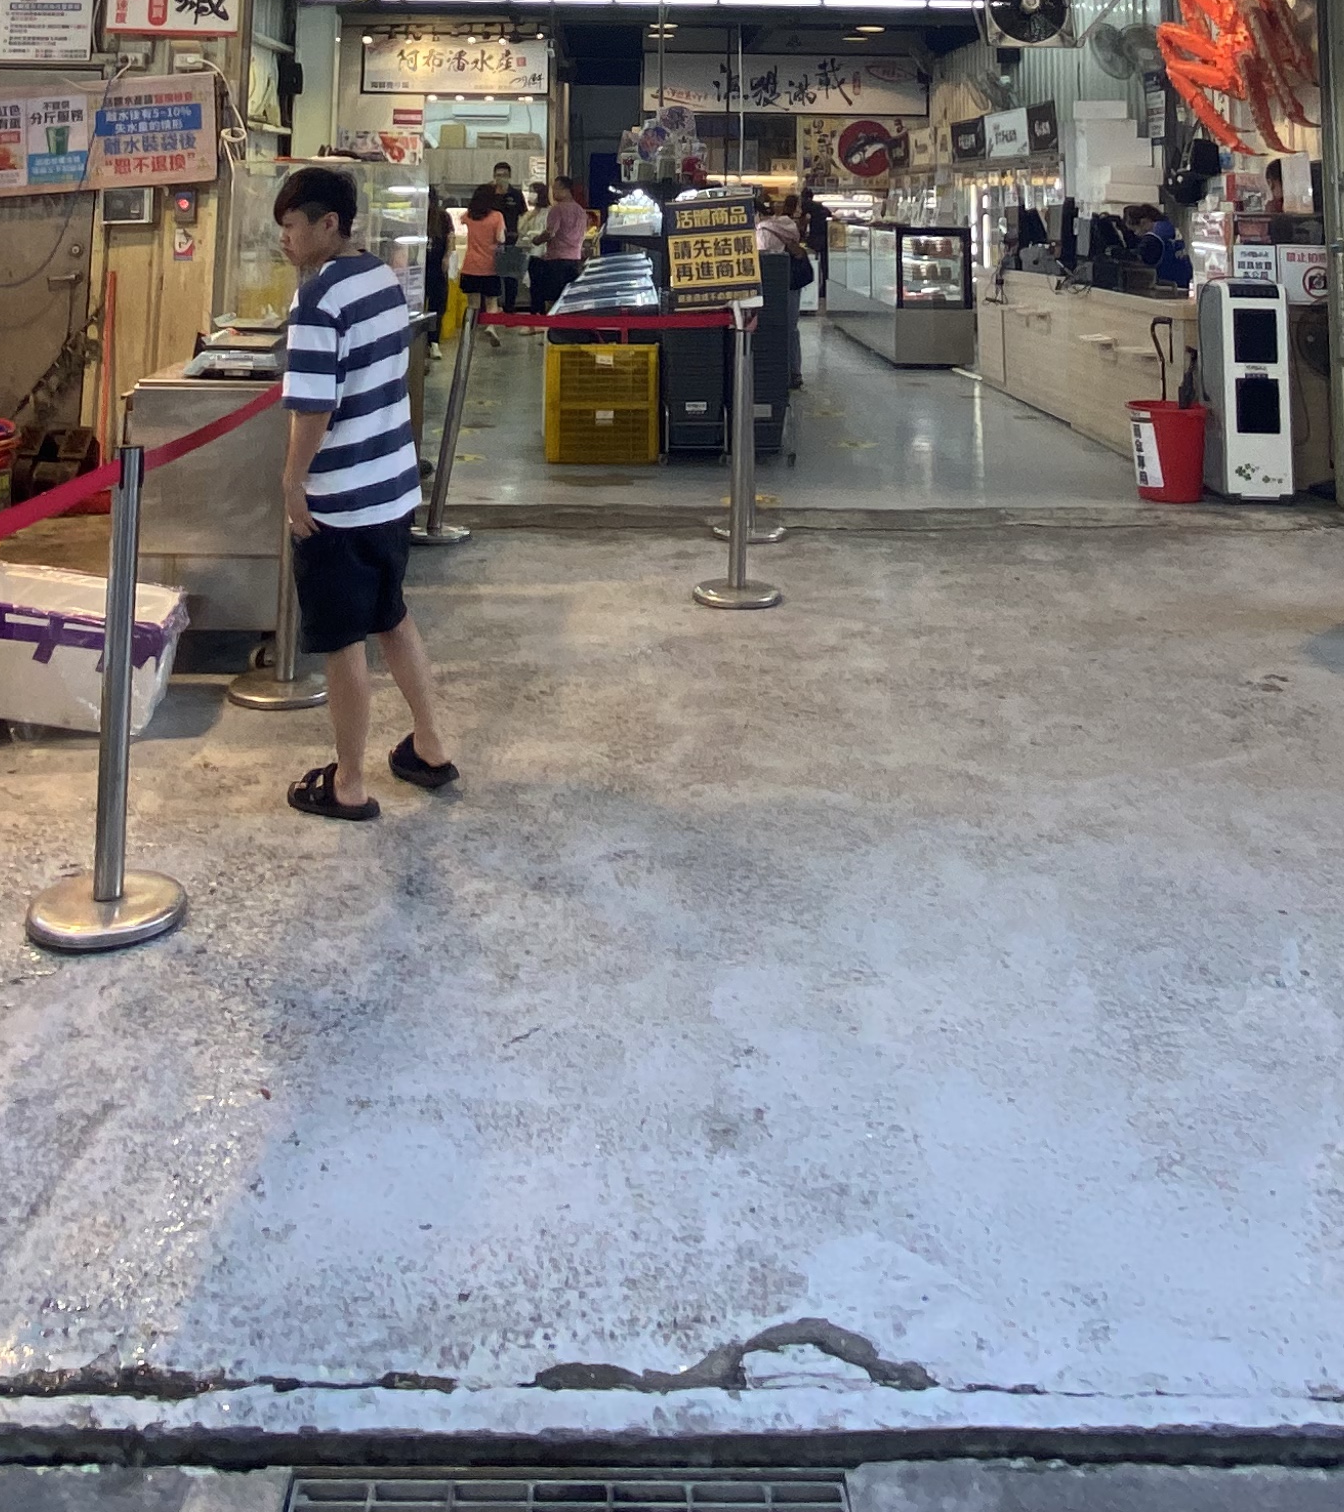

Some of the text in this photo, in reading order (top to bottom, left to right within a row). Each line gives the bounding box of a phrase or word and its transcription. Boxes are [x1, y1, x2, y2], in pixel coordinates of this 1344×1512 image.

[676, 205, 748, 229] 活體商品
[673, 235, 754, 260] 請先結帳
